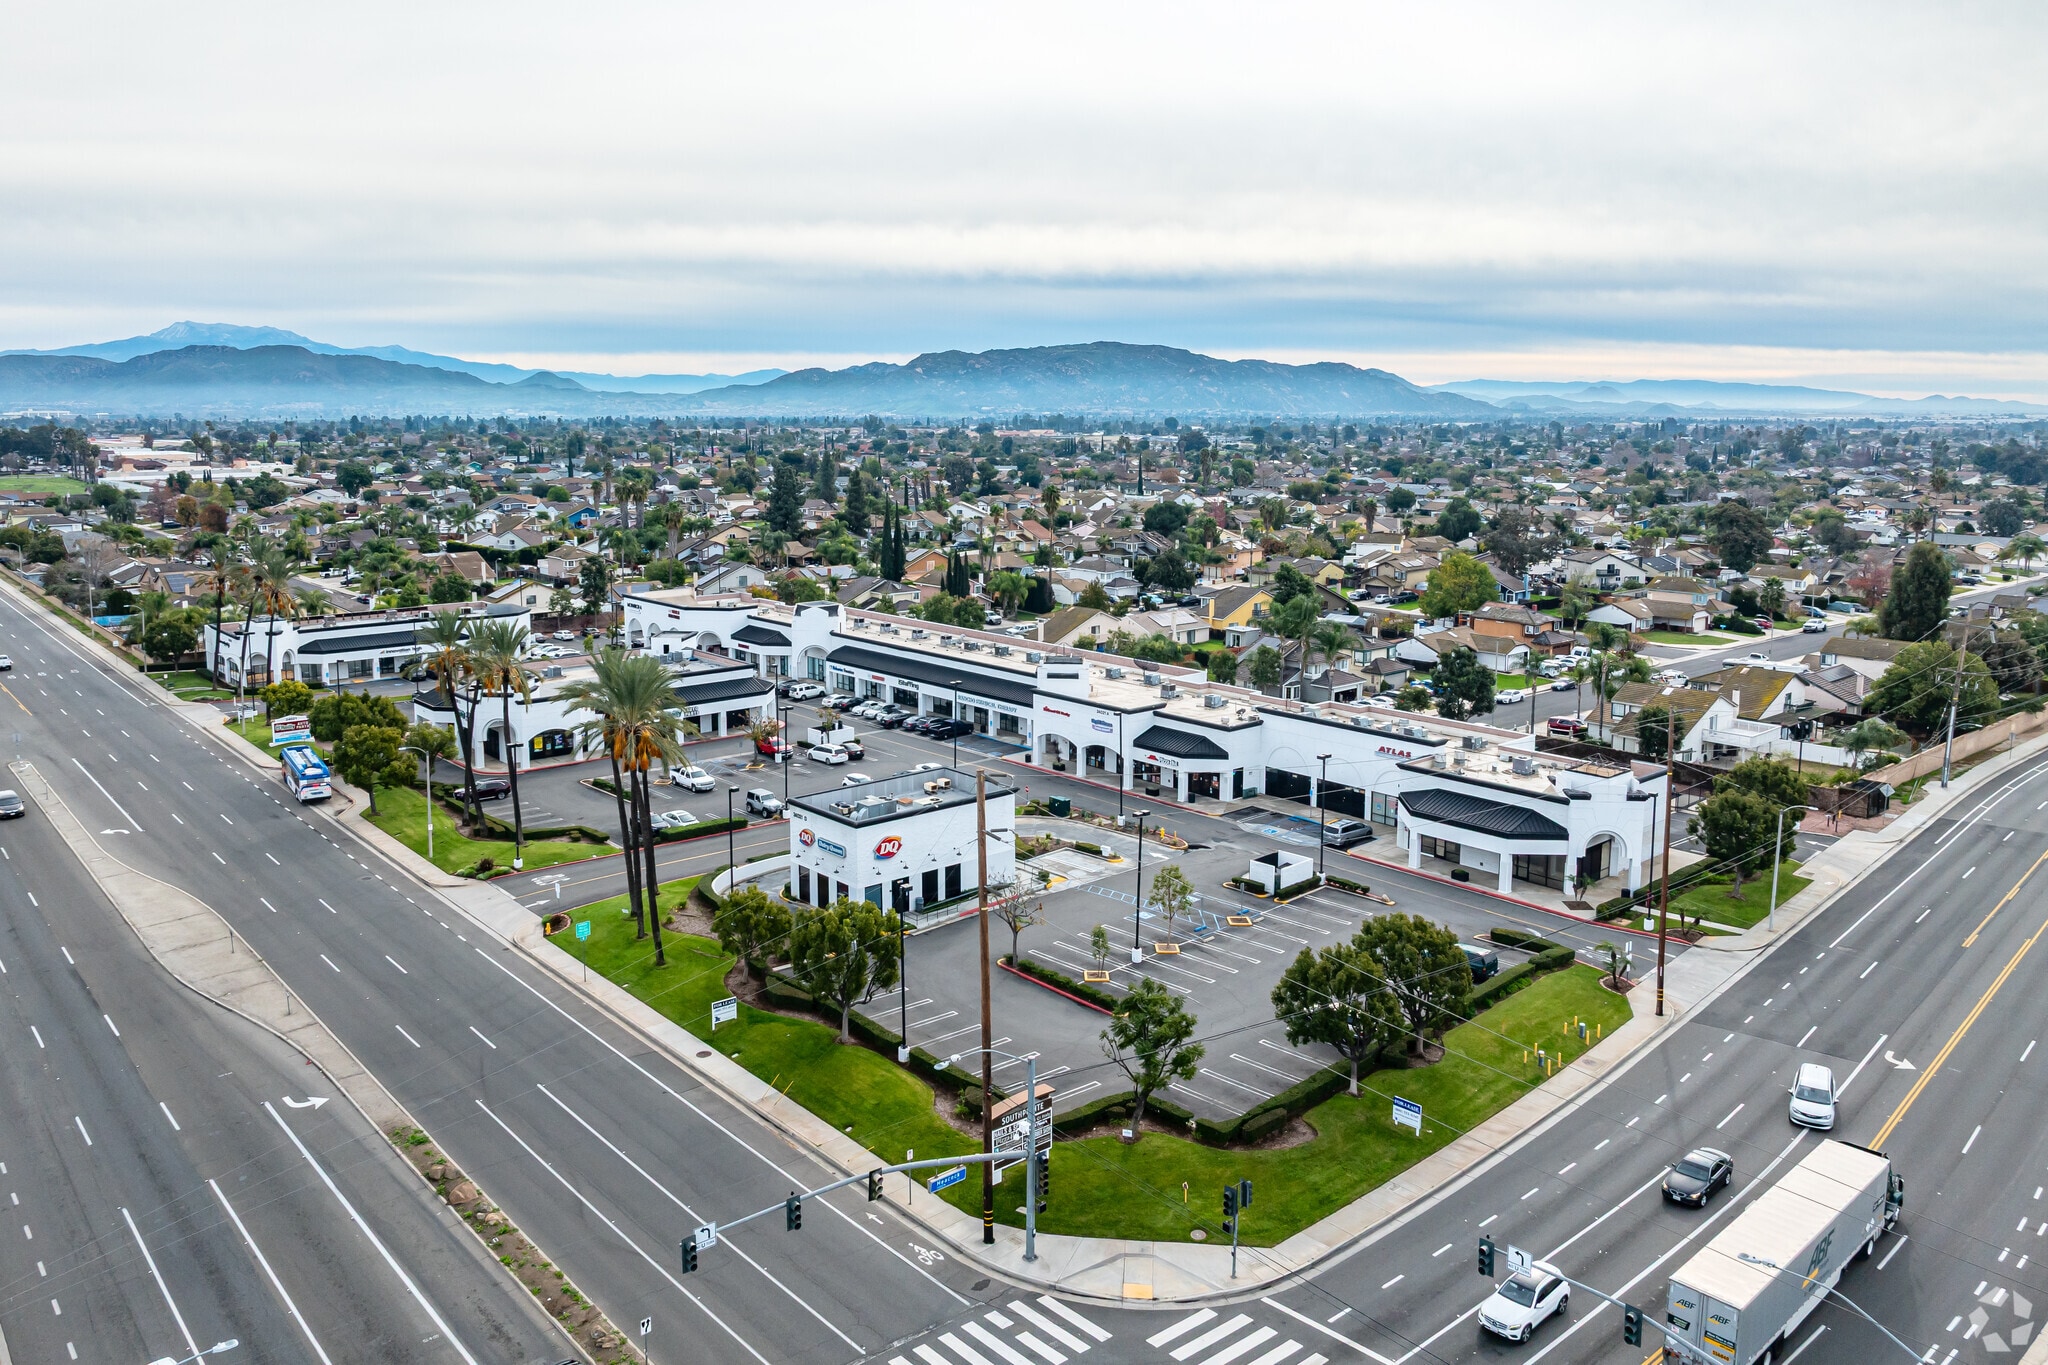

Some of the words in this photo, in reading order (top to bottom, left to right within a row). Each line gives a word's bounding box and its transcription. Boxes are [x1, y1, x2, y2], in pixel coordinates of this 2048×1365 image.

[1378, 745, 1412, 758] ATLAS
[801, 832, 812, 843] DQ
[819, 841, 830, 851] Dairy
[830, 845, 843, 855] Queen
[880, 840, 899, 854] DQ
[936, 1172, 960, 1186] Heacock
[1807, 1228, 1835, 1275] ABF
[1677, 1299, 1696, 1309] ABF
[1710, 1314, 1731, 1325] ABF
